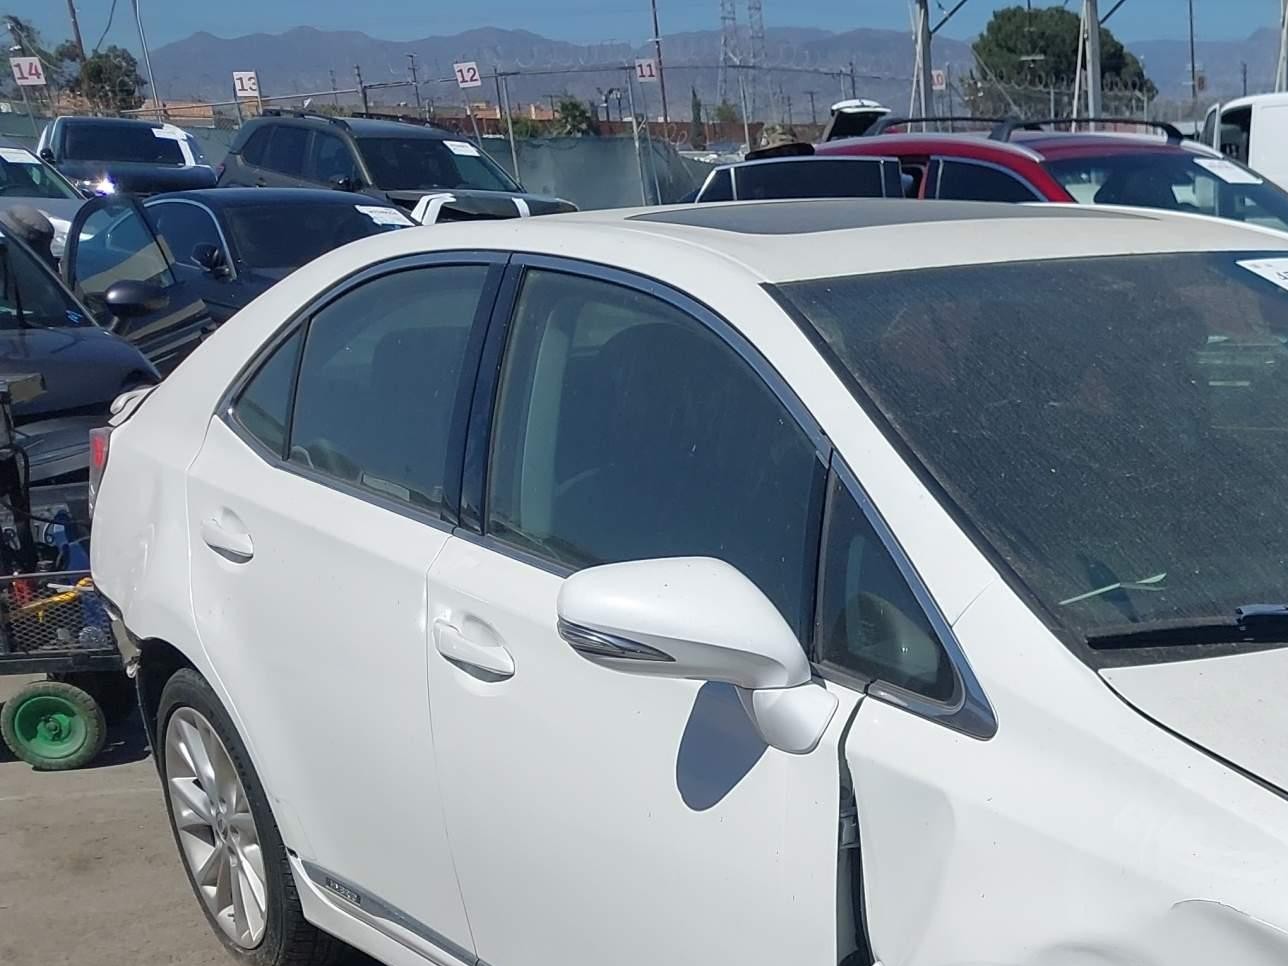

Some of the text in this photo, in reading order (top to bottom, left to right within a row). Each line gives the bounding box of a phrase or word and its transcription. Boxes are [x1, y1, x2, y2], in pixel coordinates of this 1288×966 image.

[13, 62, 42, 81] 14
[456, 67, 479, 84] 12
[637, 64, 656, 78] 11
[236, 76, 257, 92] 13
